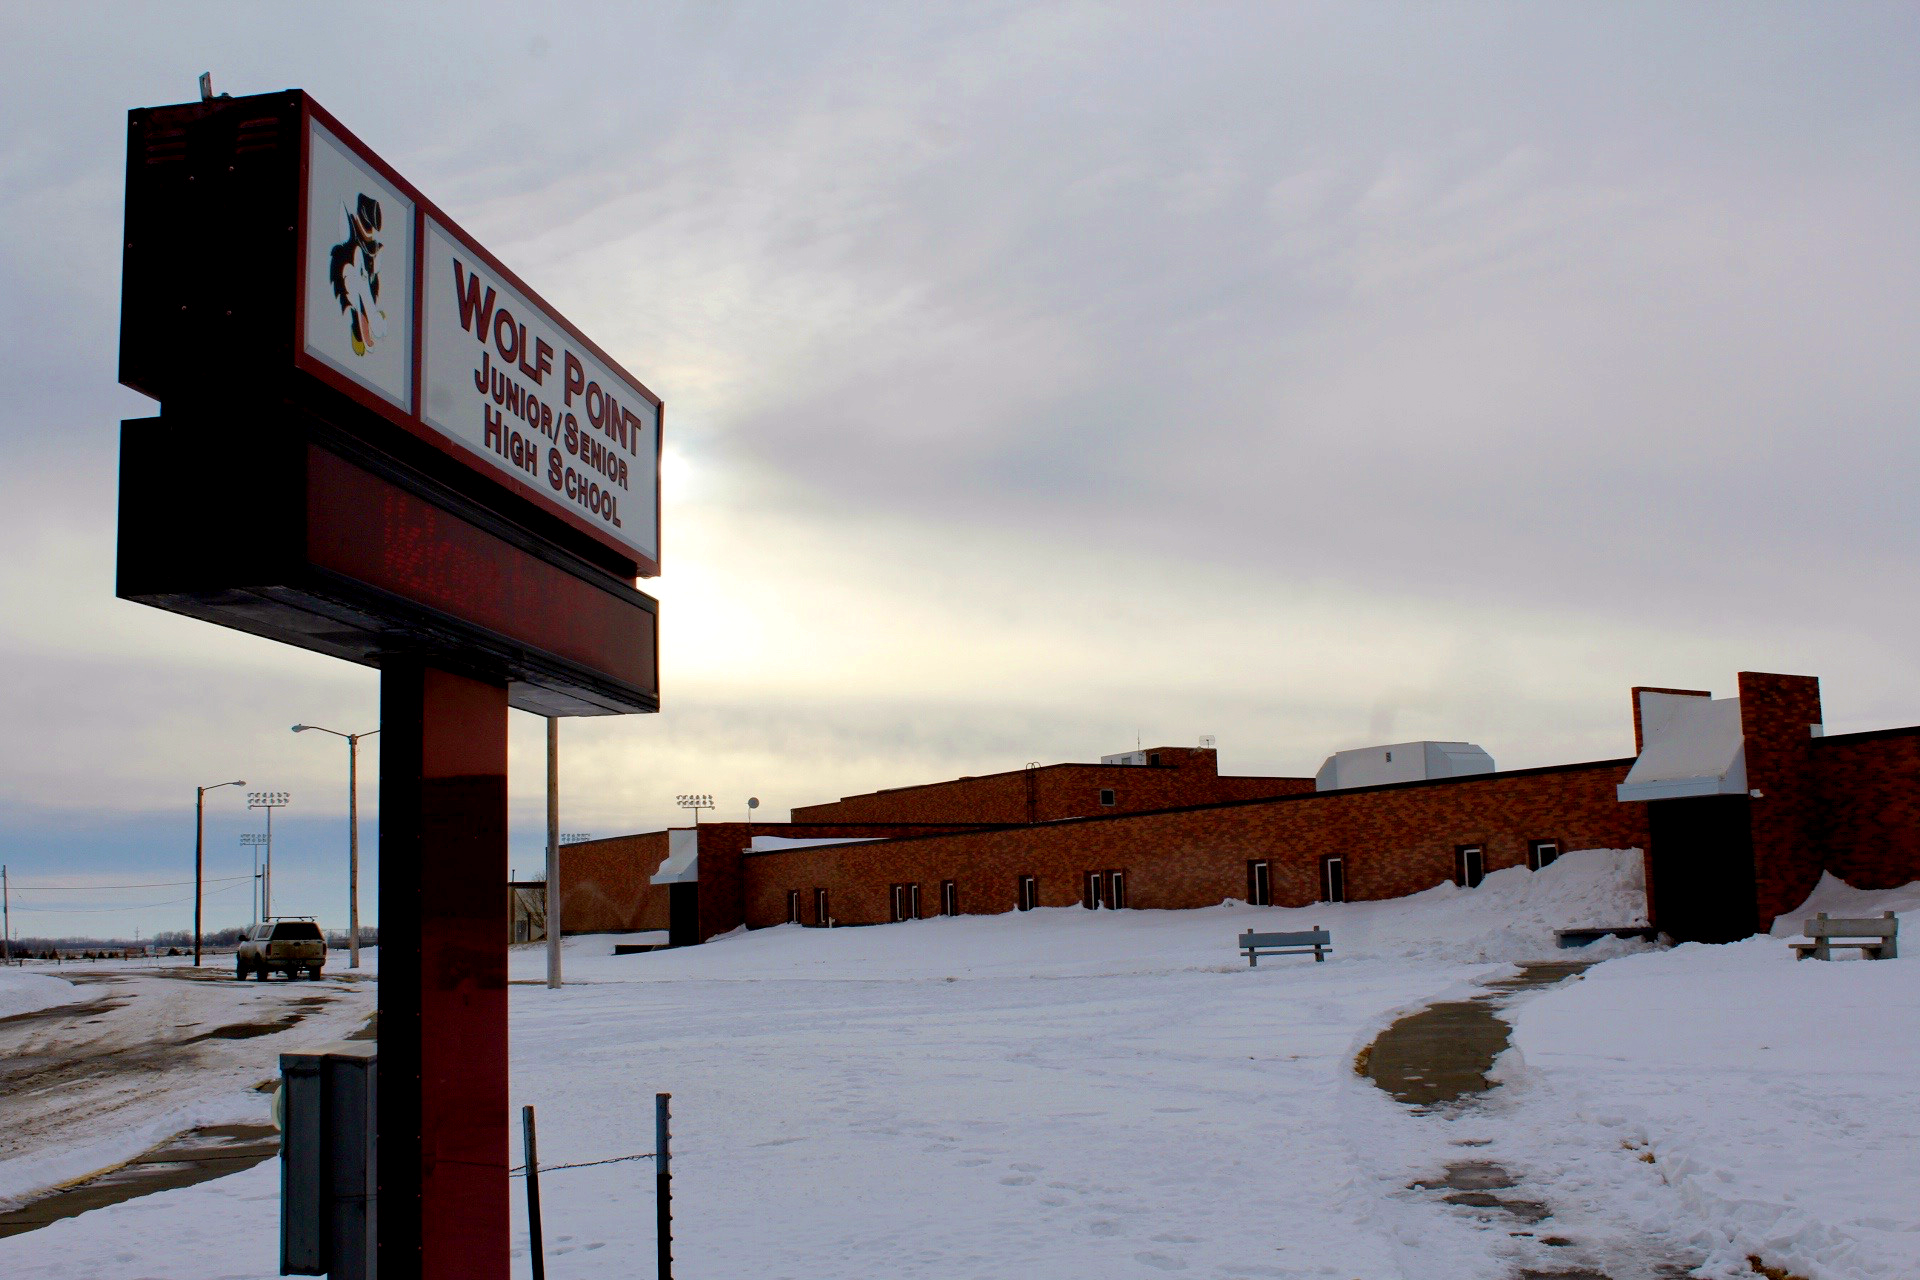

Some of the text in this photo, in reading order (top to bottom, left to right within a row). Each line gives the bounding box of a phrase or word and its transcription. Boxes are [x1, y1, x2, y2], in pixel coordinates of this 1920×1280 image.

[453, 257, 641, 457] WOLF POINT
[474, 351, 628, 491] JUNIOR/SENIOR
[484, 403, 621, 528] HIGH SCHOOL
